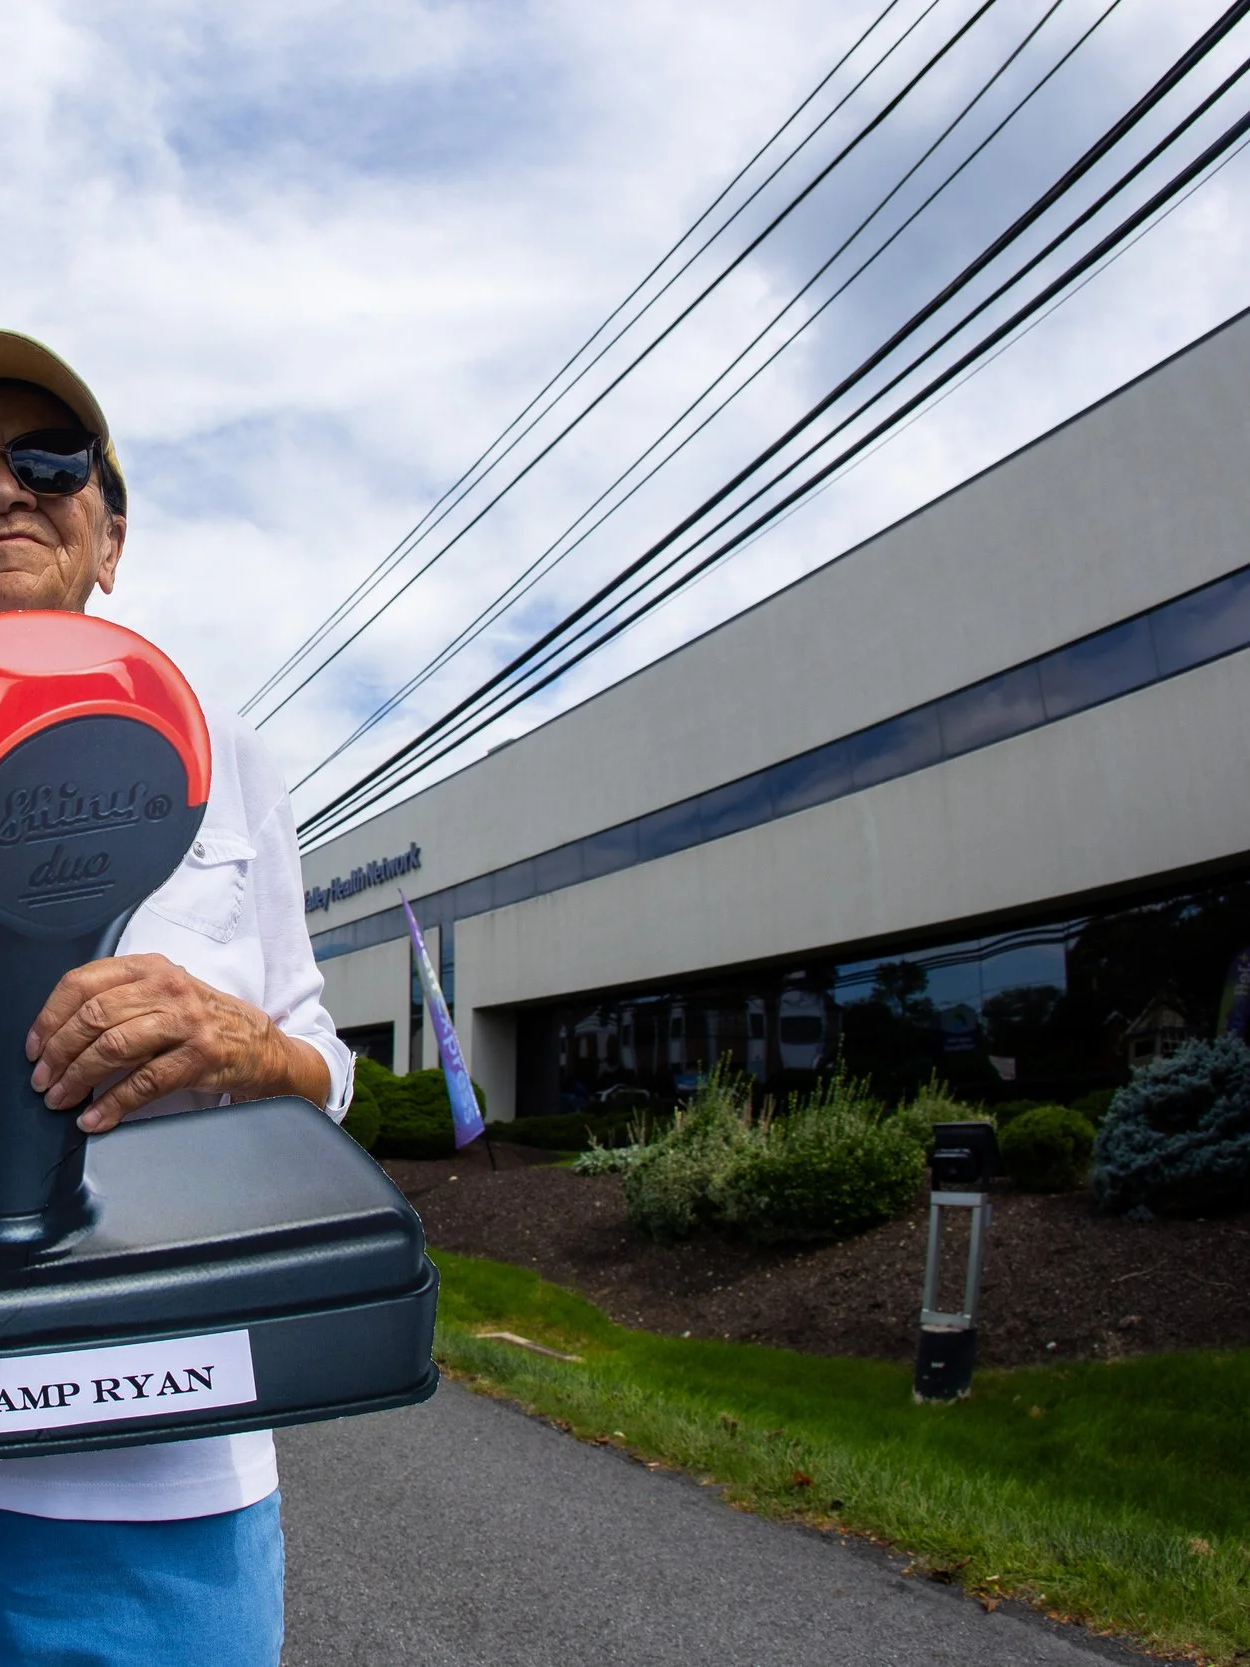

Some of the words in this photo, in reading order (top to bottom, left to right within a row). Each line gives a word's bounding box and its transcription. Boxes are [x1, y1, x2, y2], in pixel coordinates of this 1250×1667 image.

[28, 844, 111, 887] duo
[331, 867, 366, 902] Health
[367, 841, 421, 888] Network
[91, 1366, 214, 1404] RYAN
